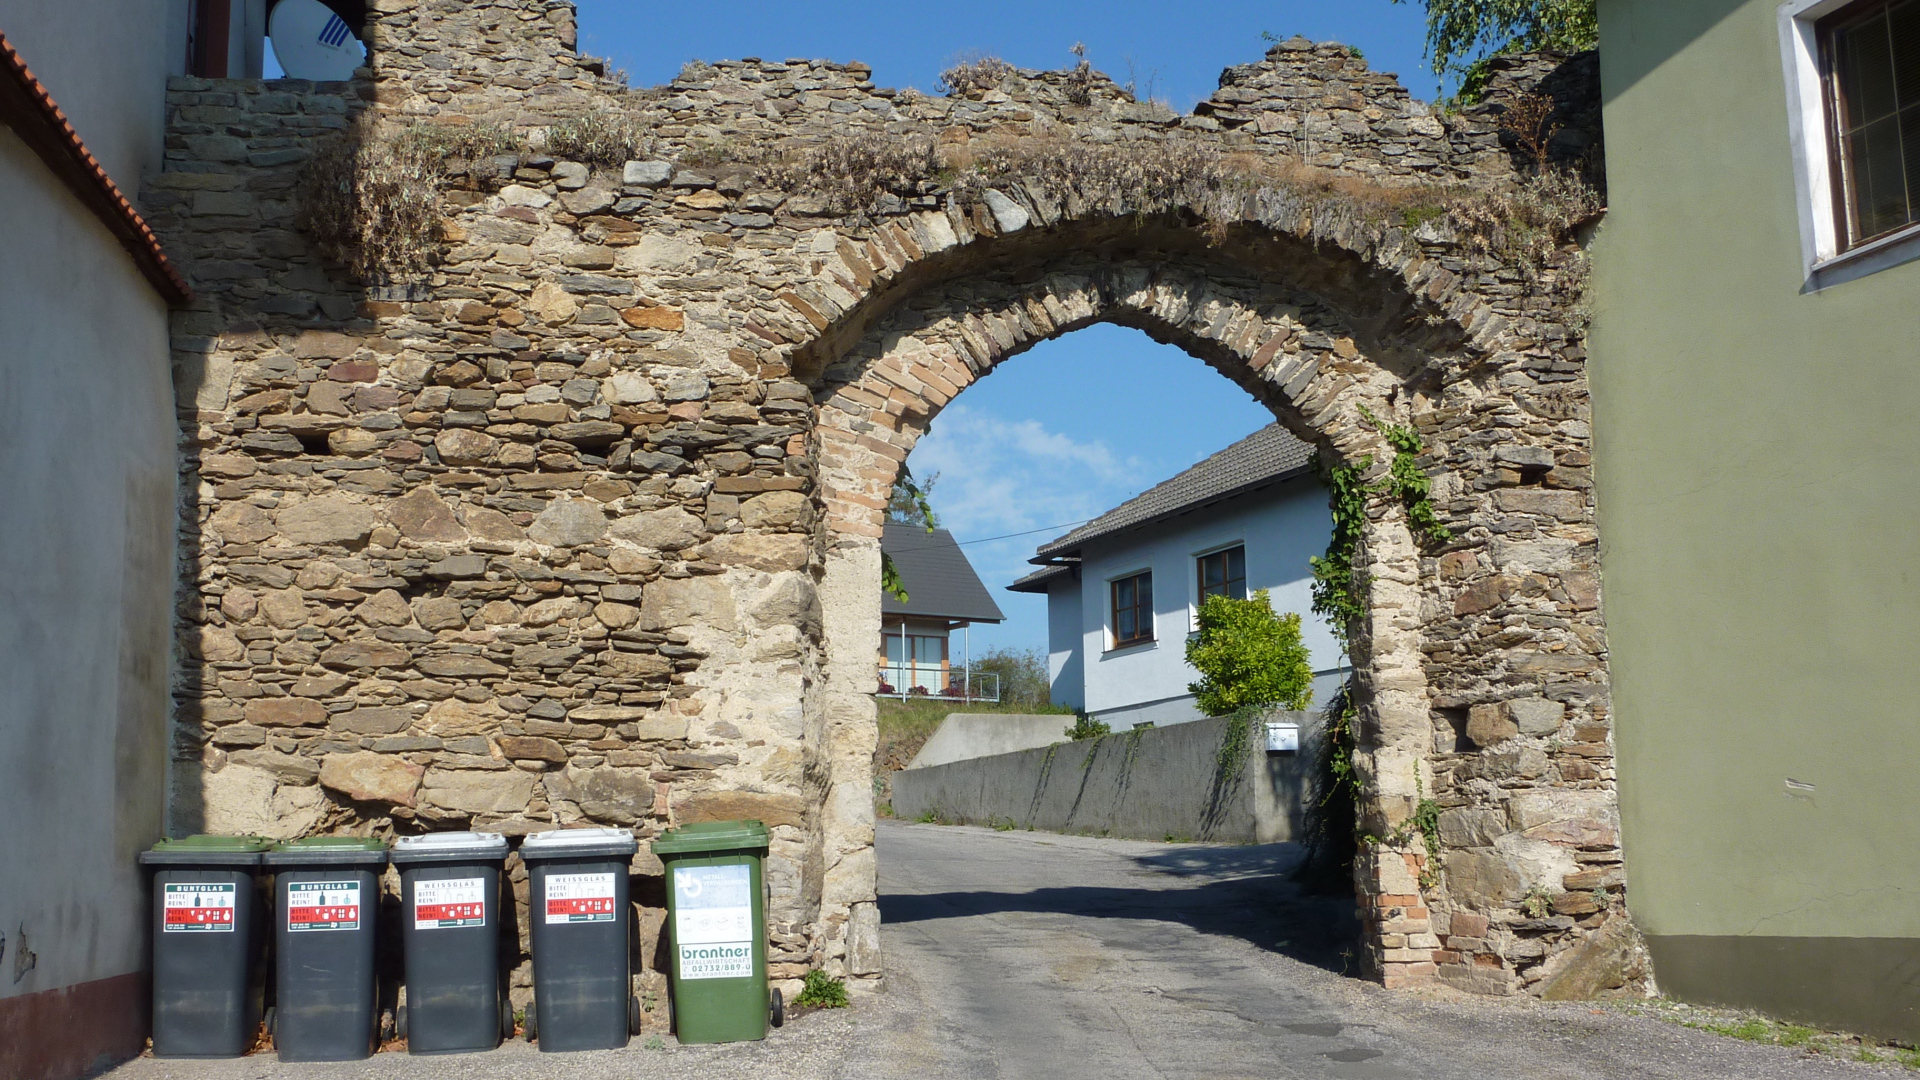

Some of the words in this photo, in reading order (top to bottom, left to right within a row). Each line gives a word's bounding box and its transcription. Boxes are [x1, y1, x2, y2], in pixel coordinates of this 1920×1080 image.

[300, 883, 348, 891] BUNTGLAS
[424, 881, 475, 889] WEISSGLAS
[681, 946, 750, 960] brantner
[682, 958, 750, 966] ABFALLWIRTSCHAFT
